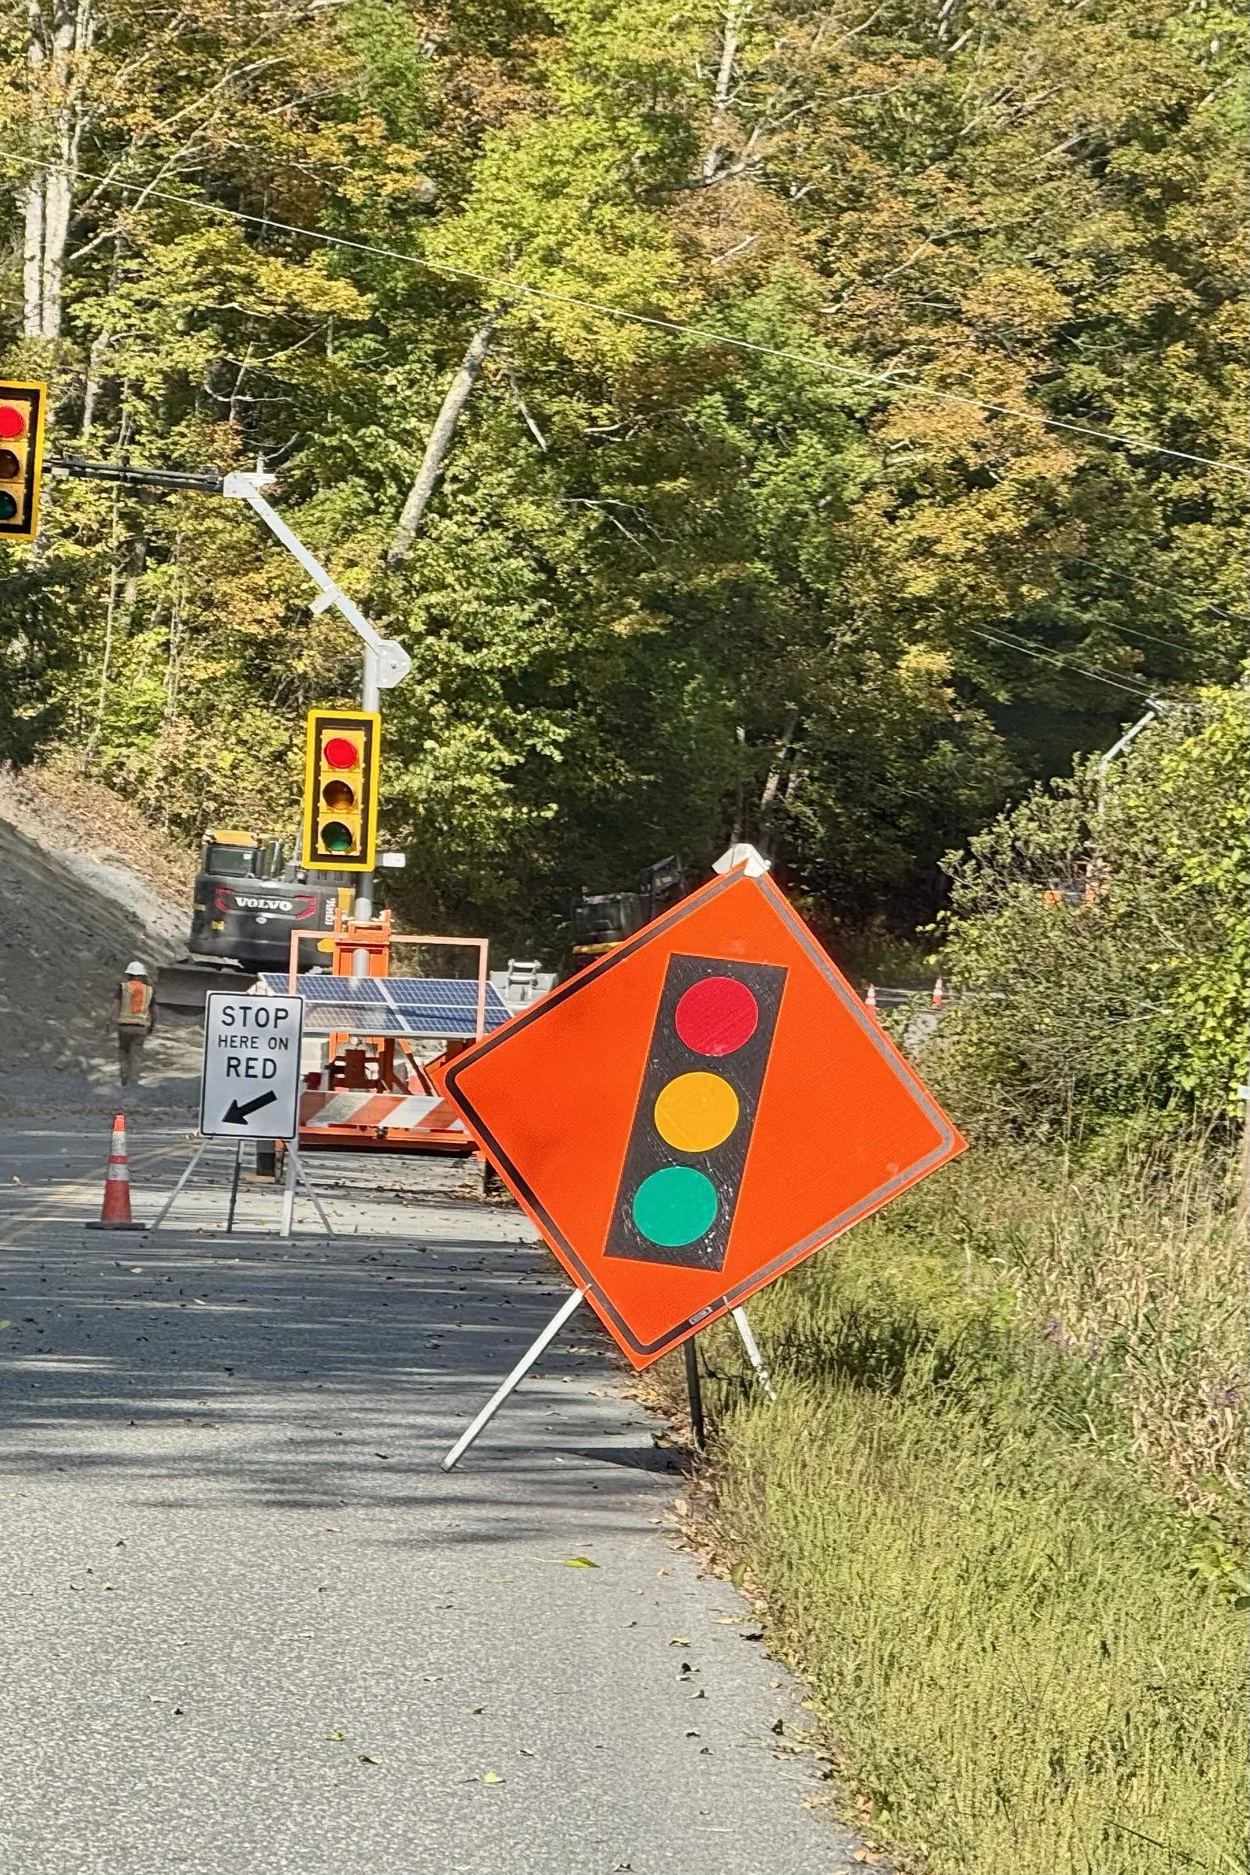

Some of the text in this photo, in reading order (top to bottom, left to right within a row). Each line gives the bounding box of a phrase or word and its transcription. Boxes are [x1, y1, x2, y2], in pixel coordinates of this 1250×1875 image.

[234, 896, 293, 912] VOLVO
[221, 1005, 290, 1029] STOP
[218, 1034, 290, 1051] HERE ON
[226, 1056, 278, 1080] RED
